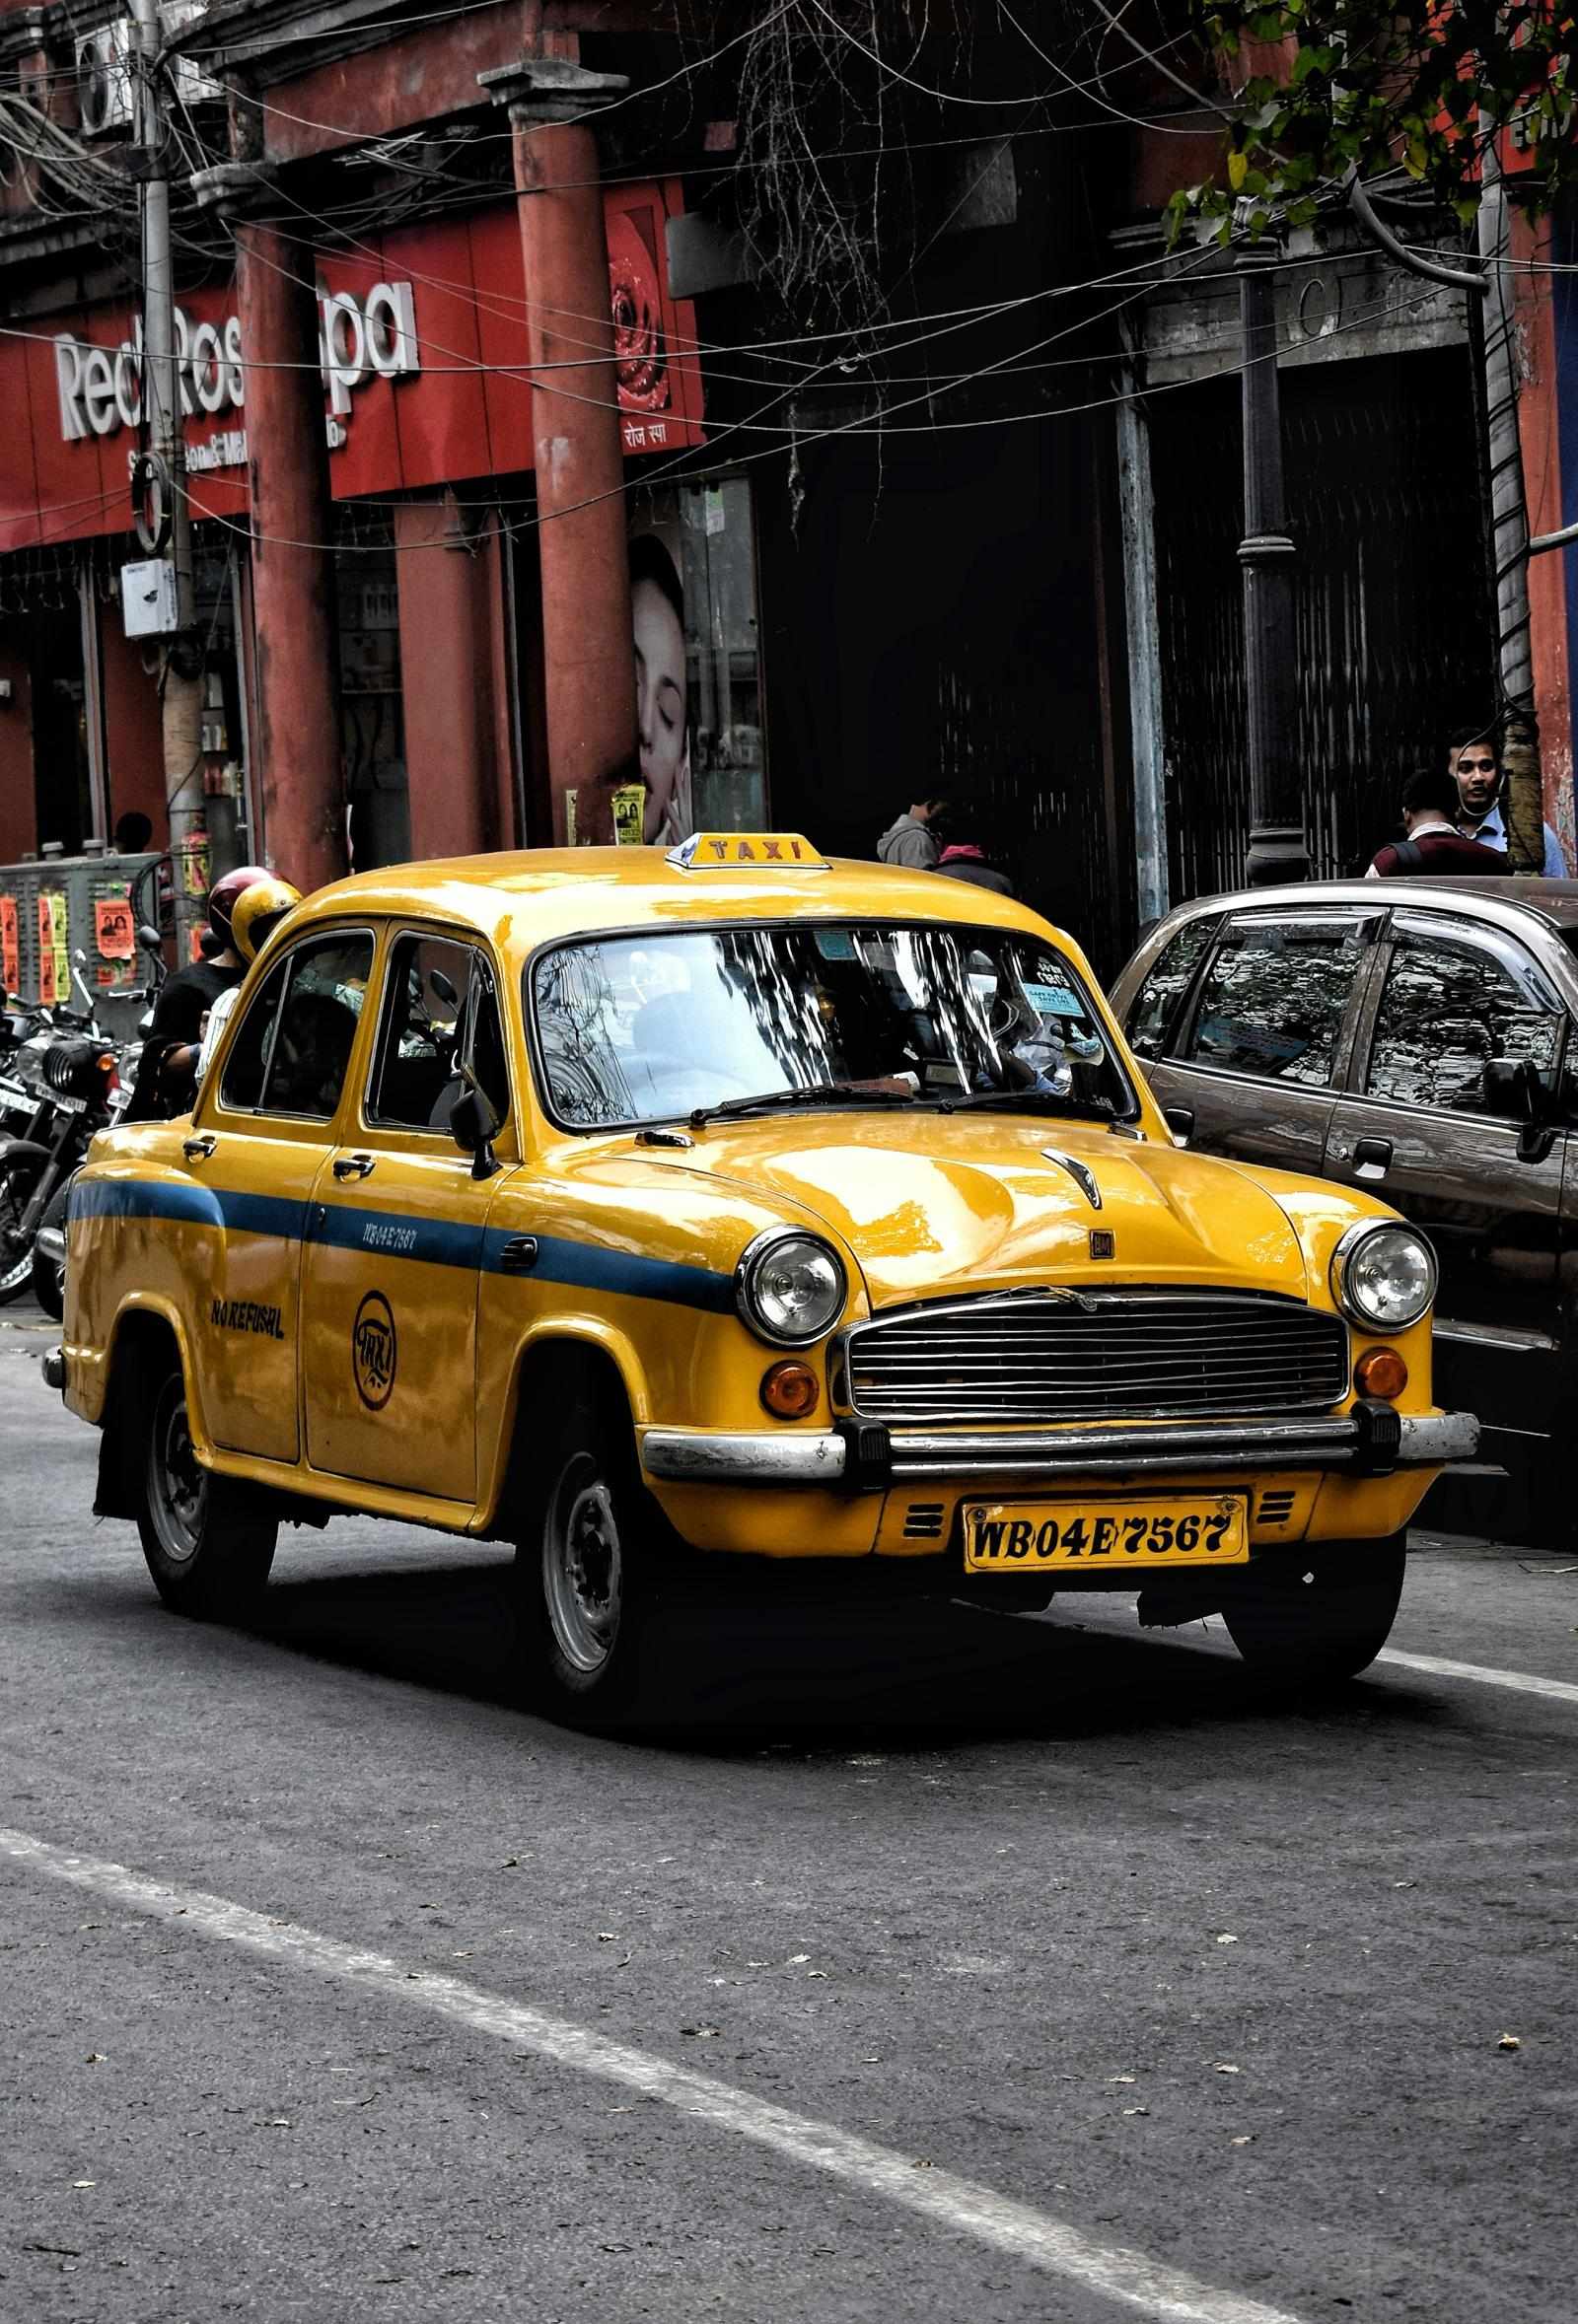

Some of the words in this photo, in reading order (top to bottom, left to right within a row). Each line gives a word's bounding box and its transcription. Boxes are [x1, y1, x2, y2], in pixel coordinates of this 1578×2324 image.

[708, 840, 802, 860] TAXI
[211, 1300, 228, 1328] NO
[228, 1301, 285, 1341] REFUSAL
[972, 1514, 1232, 1559] WB04E7567
